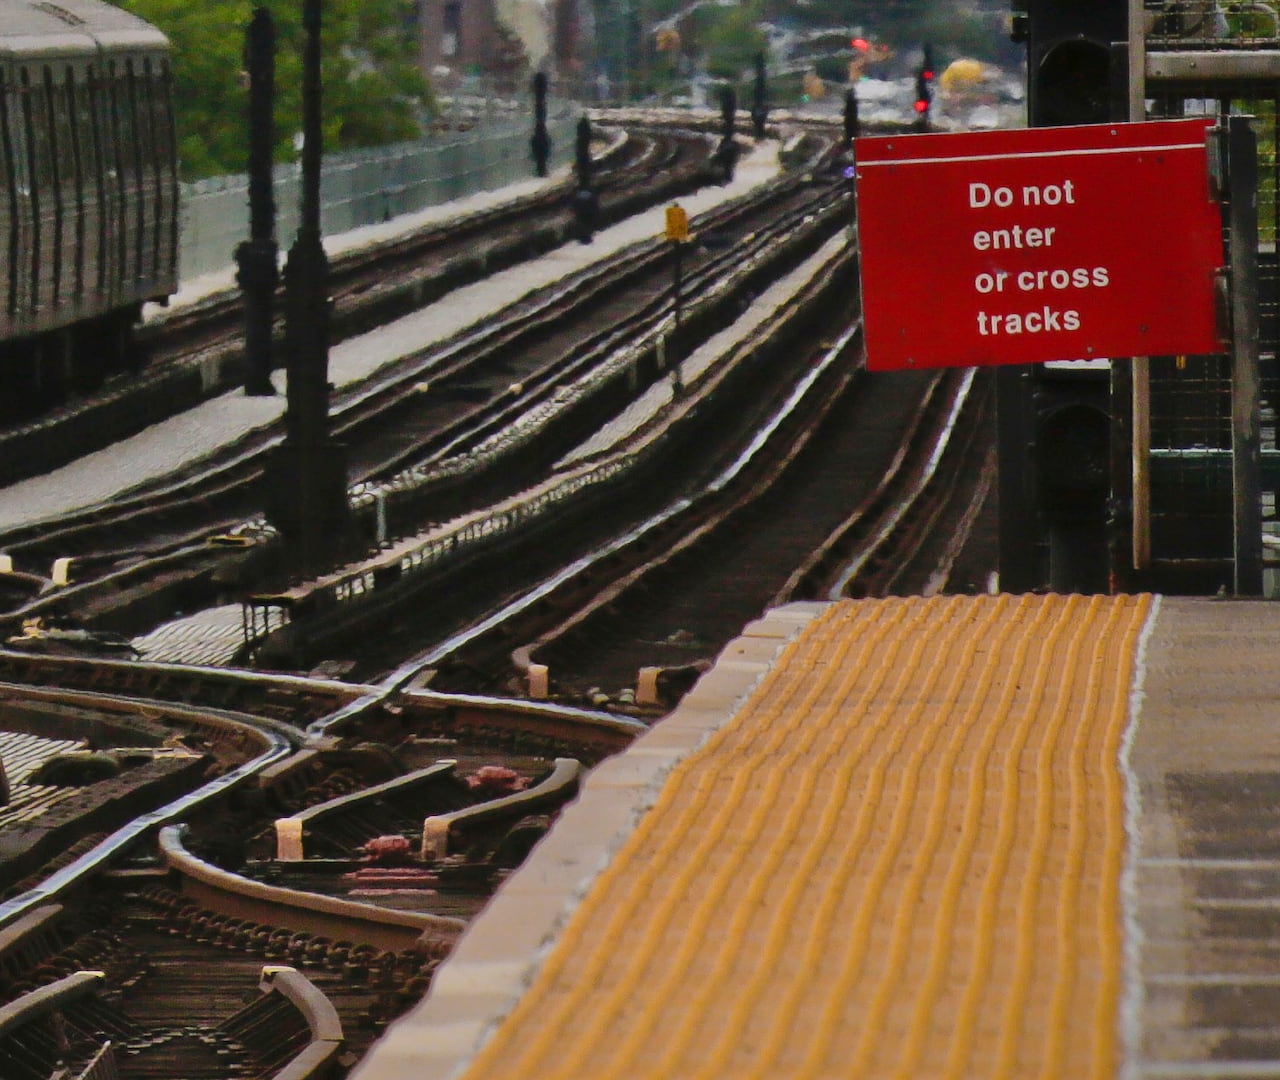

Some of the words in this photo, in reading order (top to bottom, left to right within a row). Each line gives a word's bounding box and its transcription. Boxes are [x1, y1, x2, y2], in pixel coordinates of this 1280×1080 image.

[969, 182, 1014, 208] Do
[1023, 179, 1075, 206] not
[973, 224, 1056, 251] enter
[975, 272, 1008, 293] or
[1017, 266, 1109, 291] cross
[976, 305, 1080, 336] tracks
